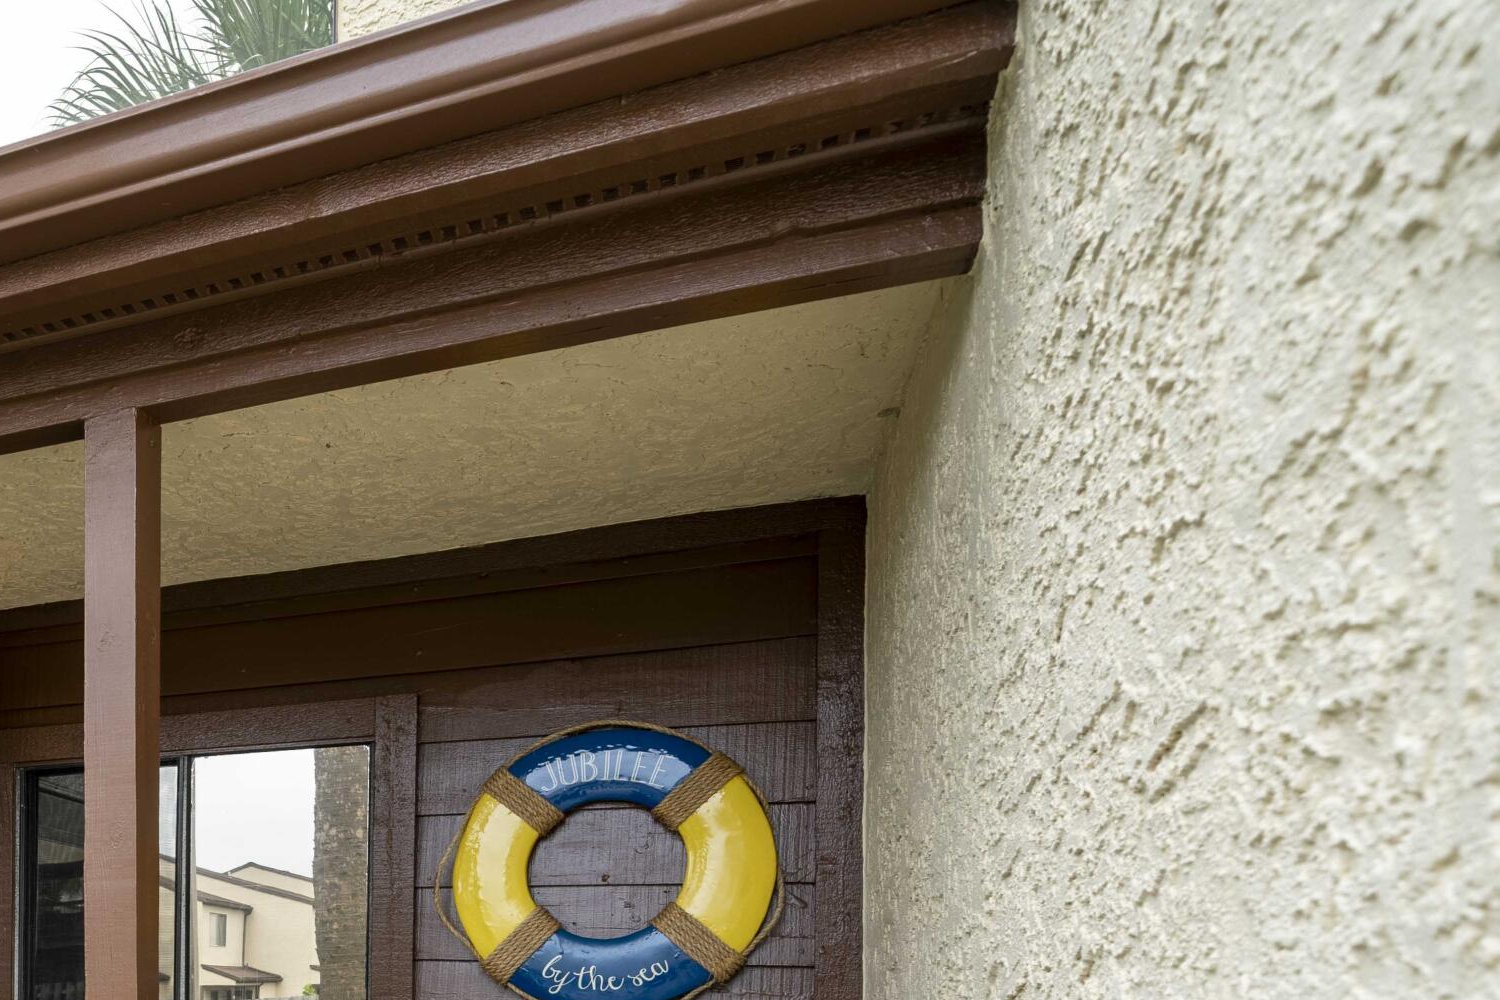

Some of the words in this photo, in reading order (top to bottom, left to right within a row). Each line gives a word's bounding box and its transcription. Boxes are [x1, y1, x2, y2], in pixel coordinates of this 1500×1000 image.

[538, 750, 674, 791] JUBILEE
[542, 955, 576, 994] by
[573, 965, 624, 991] the
[627, 960, 669, 987] sea
